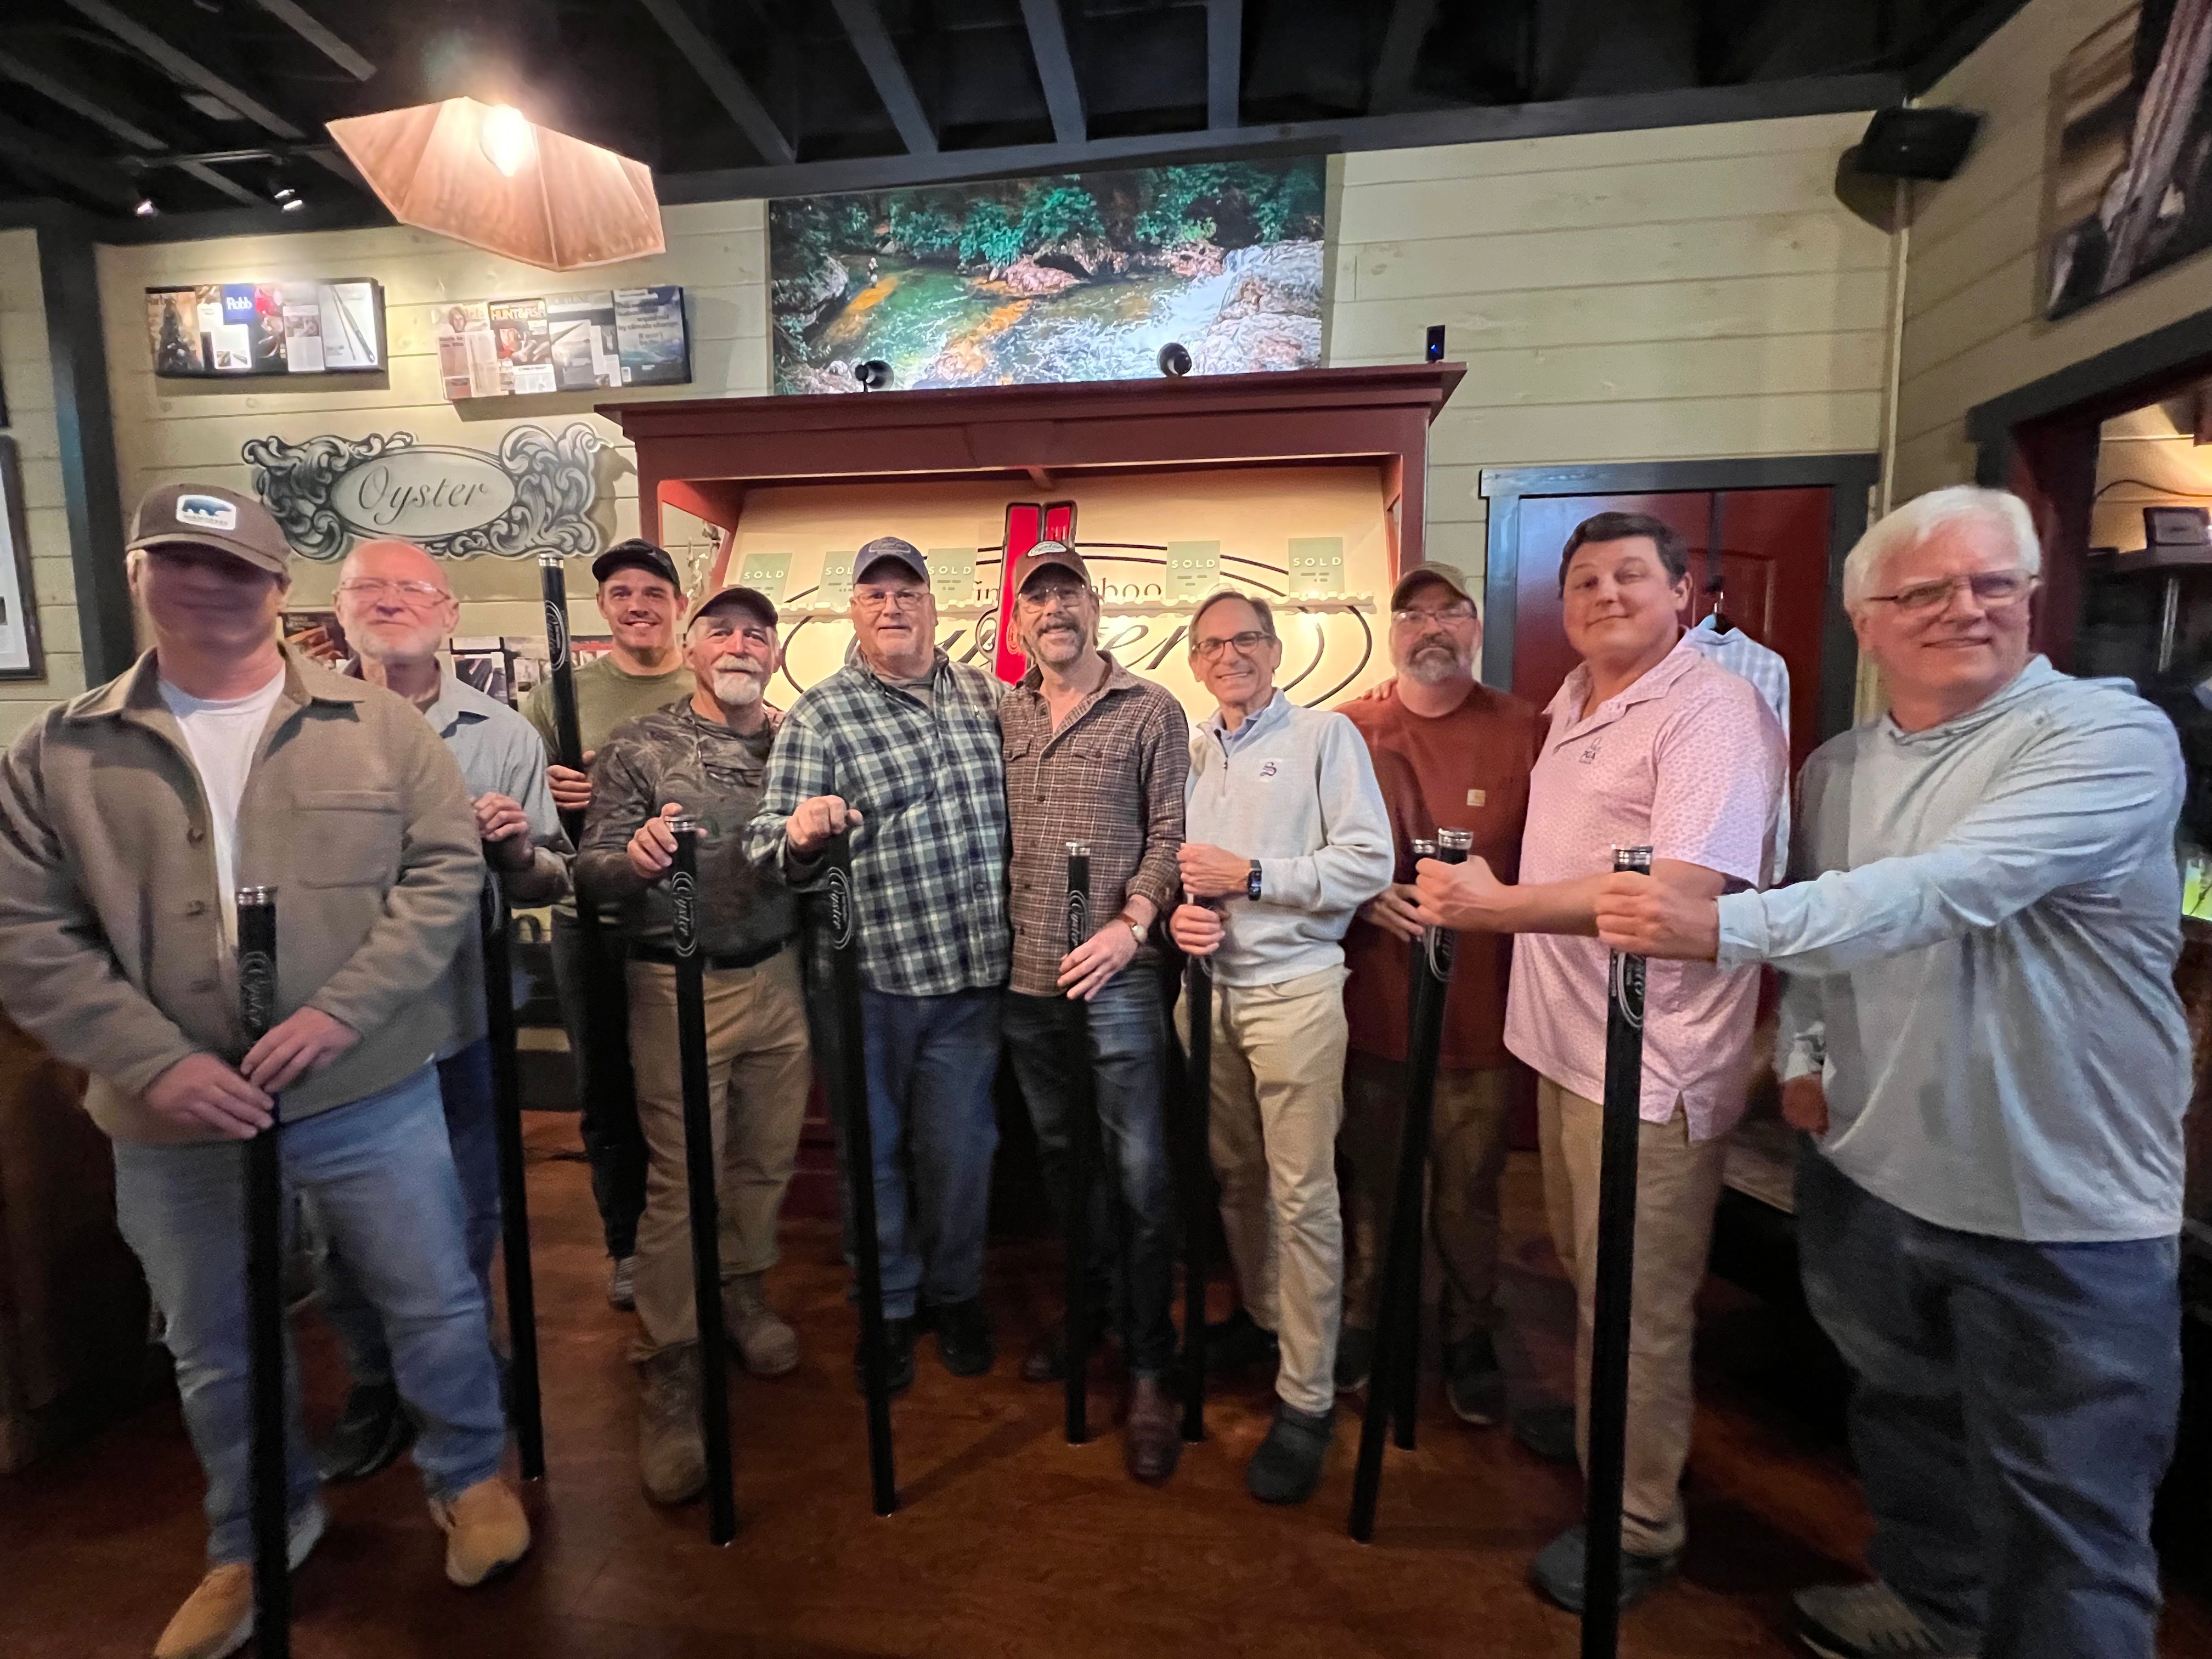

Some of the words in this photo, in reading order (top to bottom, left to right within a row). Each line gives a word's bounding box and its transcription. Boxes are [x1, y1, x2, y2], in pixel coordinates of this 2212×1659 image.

[227, 296, 253, 310] Robb
[358, 465, 488, 525] Oyster
[1171, 558, 1216, 569] SOLD
[1293, 556, 1342, 567] SOLD
[743, 569, 785, 580] SOLD
[825, 566, 853, 576] SOL
[927, 565, 972, 575] SOLD
